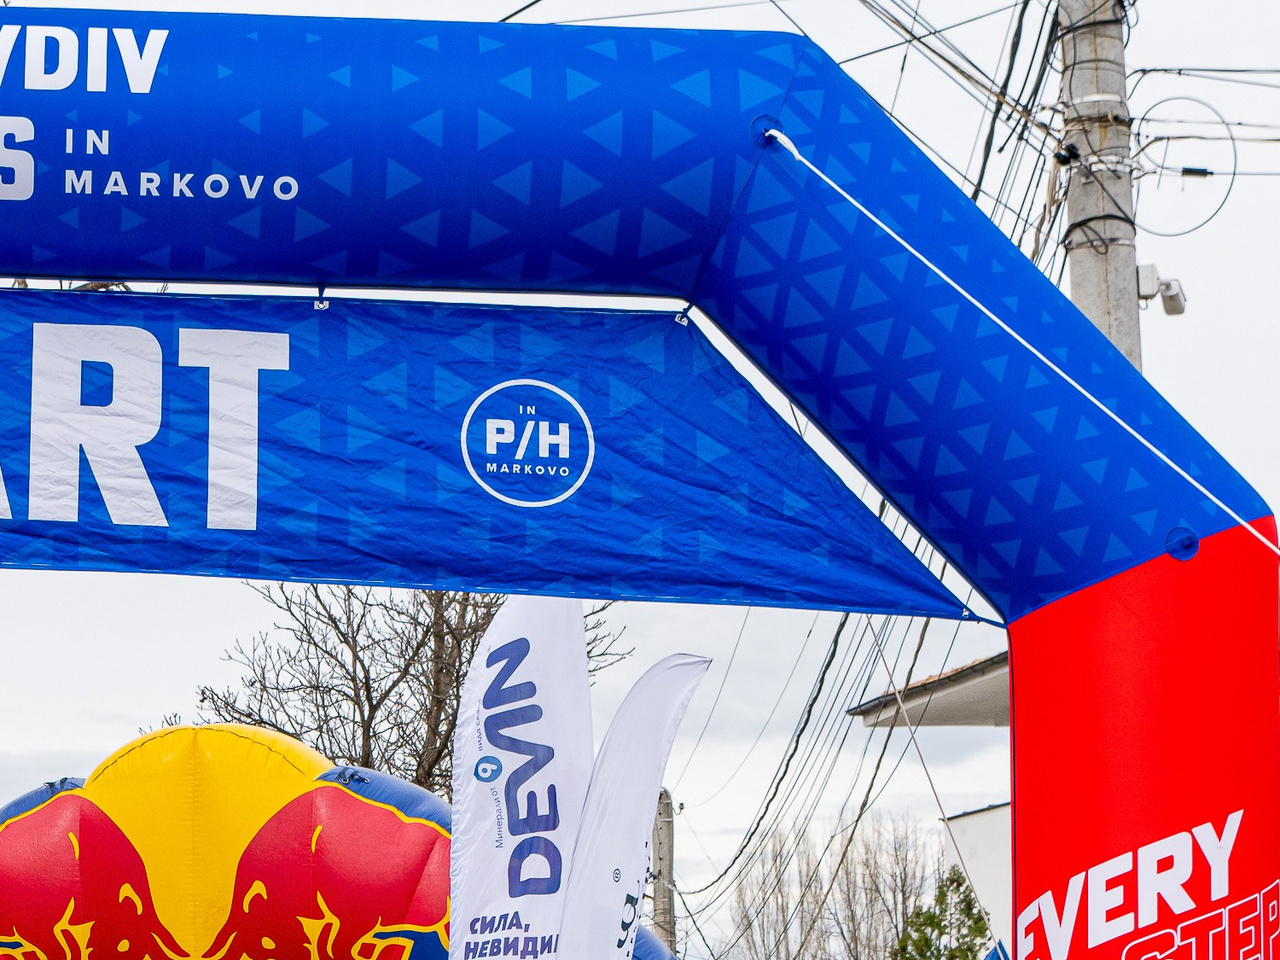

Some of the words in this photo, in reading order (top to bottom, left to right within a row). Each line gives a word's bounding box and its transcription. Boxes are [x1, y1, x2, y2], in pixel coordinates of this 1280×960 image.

[65, 129, 110, 156] IN
[65, 169, 300, 201] MARKOVO
[519, 405, 536, 415] IN
[486, 418, 569, 460] P/H
[486, 463, 569, 477] MARKOVO
[482, 637, 563, 899] DEVIN
[469, 910, 531, 935] СИЛА,
[463, 934, 559, 960] НЕВИДИ
